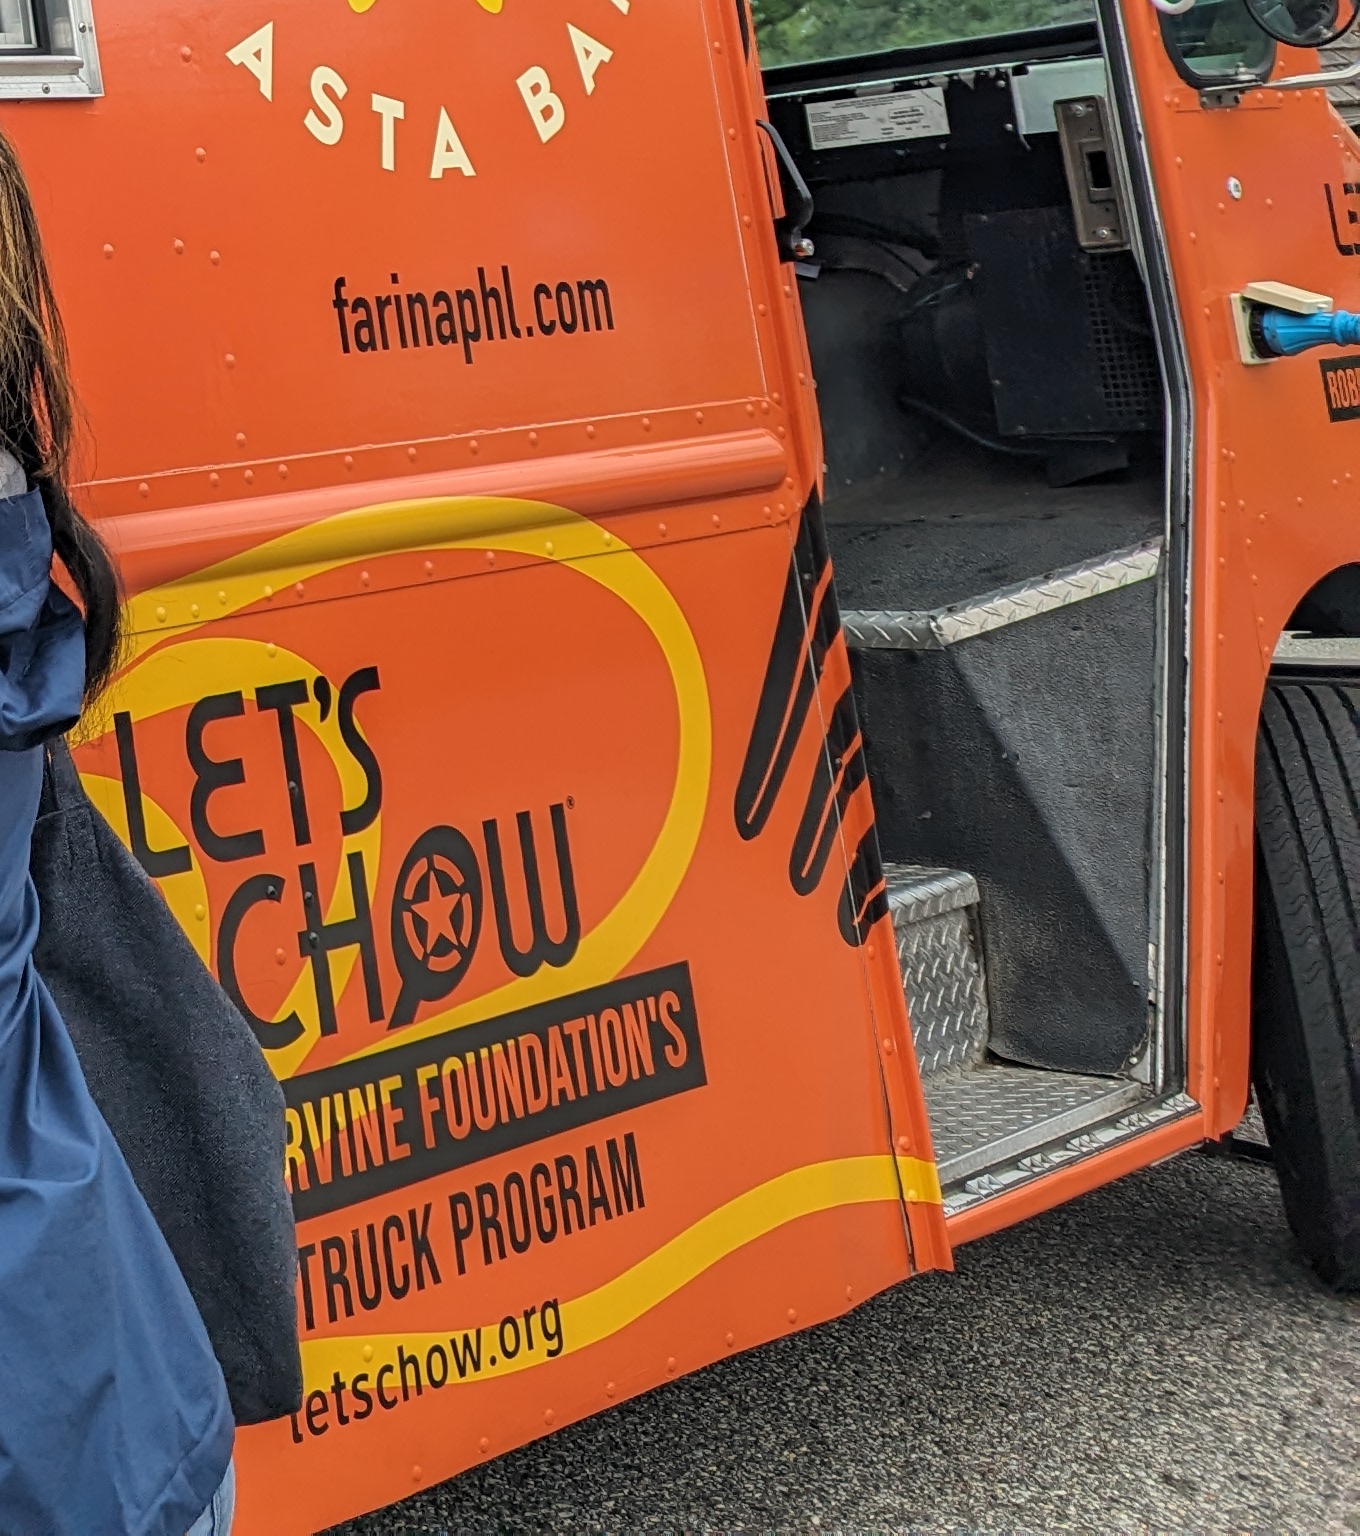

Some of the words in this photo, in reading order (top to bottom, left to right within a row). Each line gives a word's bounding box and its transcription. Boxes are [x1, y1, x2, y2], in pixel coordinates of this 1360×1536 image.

[332, 266, 614, 364] farinaphl.com
[1326, 367, 1360, 409] ROB
[113, 665, 382, 878] LET'S
[284, 1074, 411, 1195] RVINE
[417, 989, 689, 1149] FOUNDATION'S
[297, 1202, 442, 1332] TRUCK
[448, 1132, 646, 1276] PROGRAM
[290, 1298, 564, 1444] etschow.org
